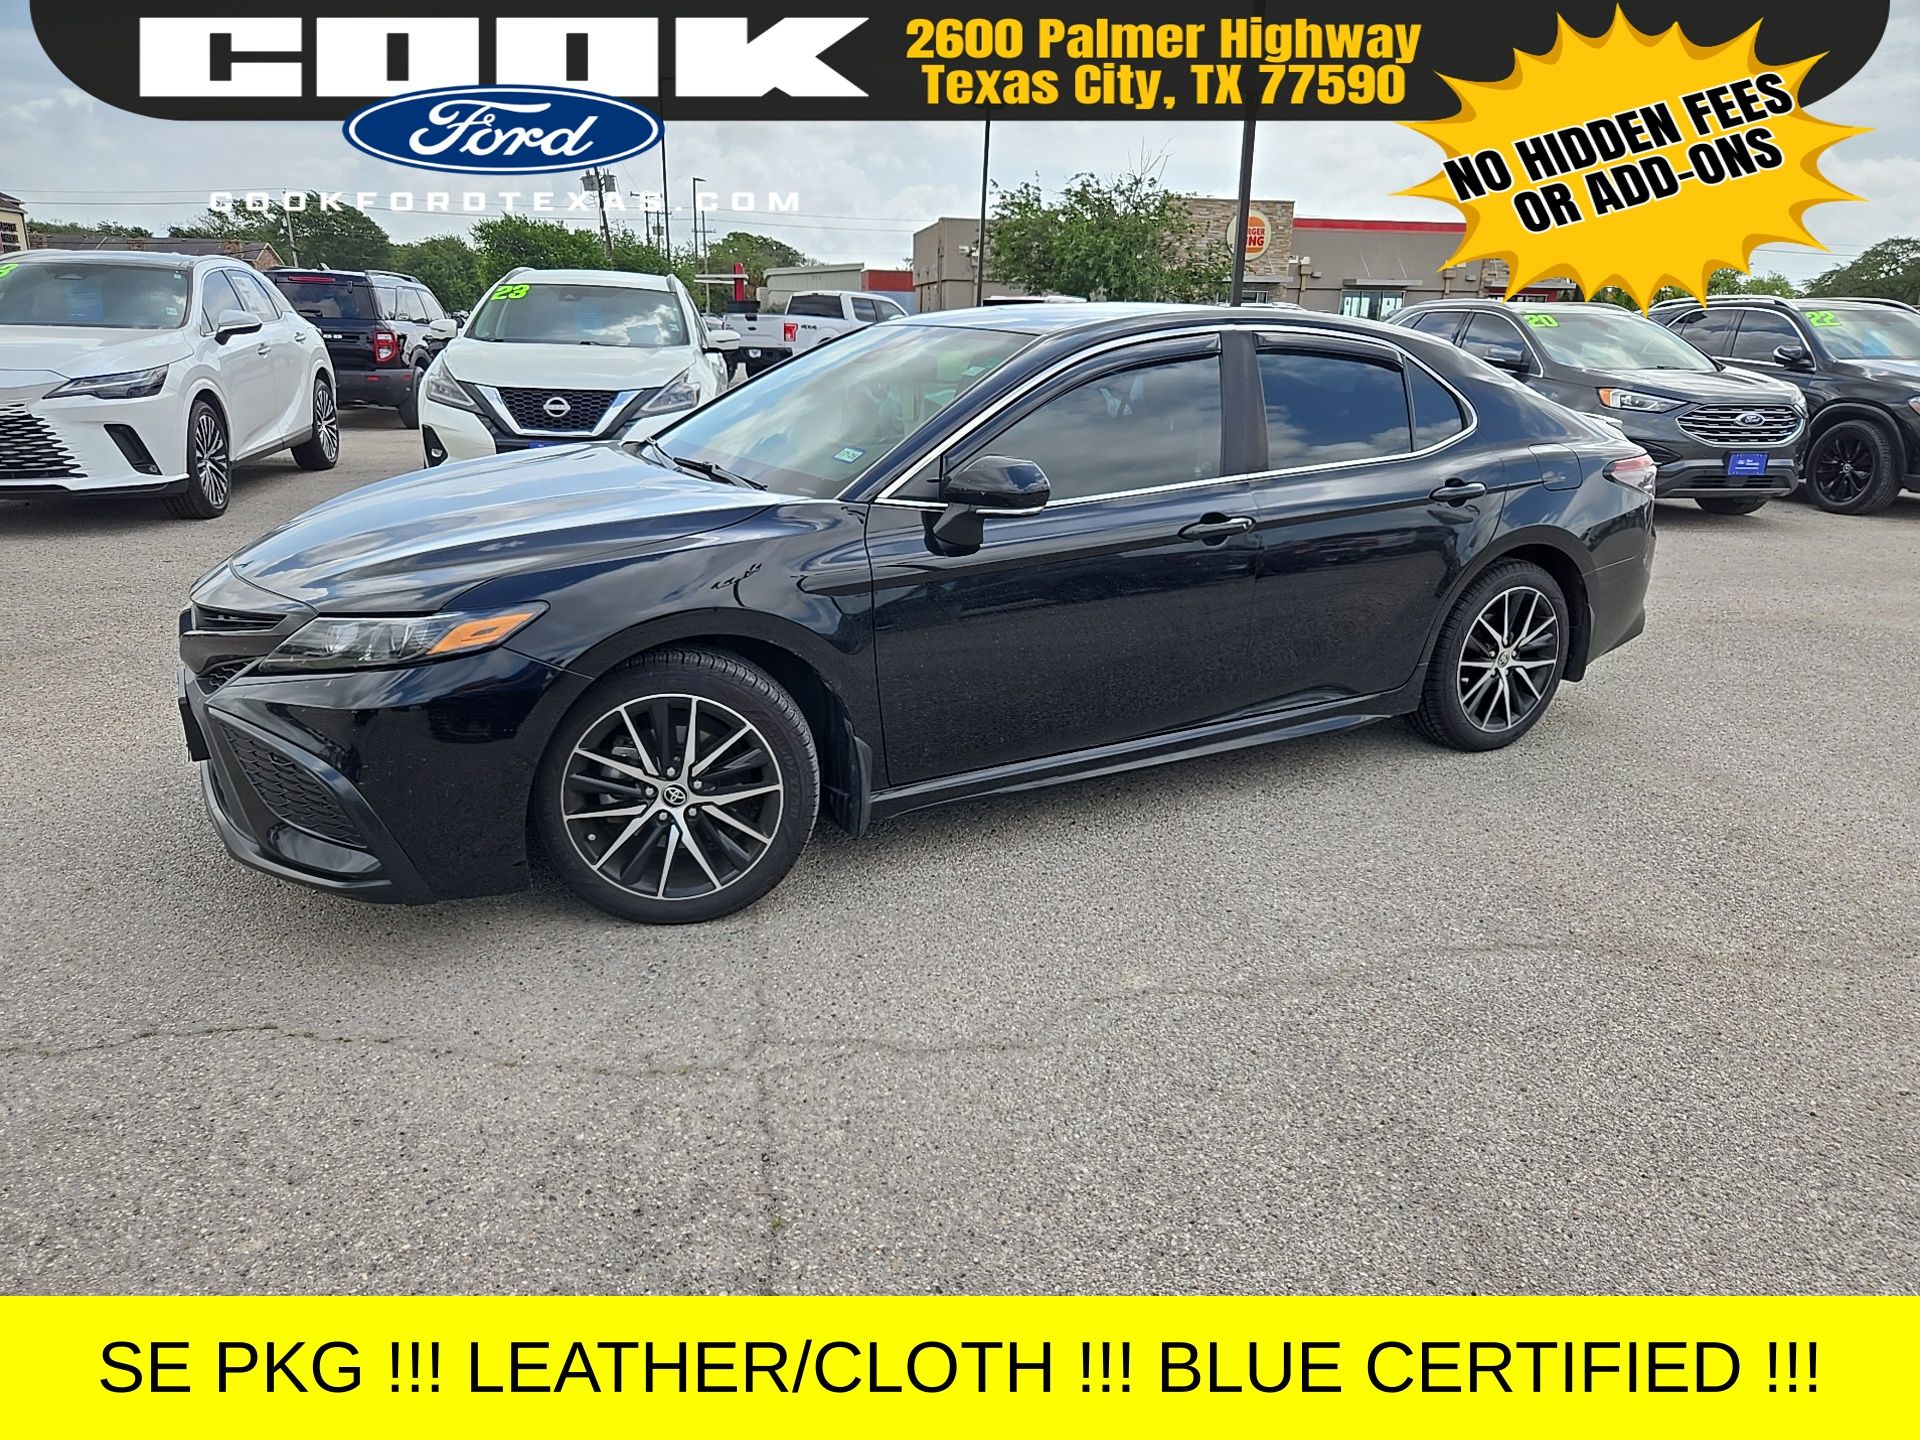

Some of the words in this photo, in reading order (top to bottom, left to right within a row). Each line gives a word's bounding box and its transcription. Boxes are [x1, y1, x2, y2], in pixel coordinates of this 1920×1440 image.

[491, 284, 530, 300] 23
[1523, 314, 1560, 329] 20
[1804, 311, 1841, 328] 22
